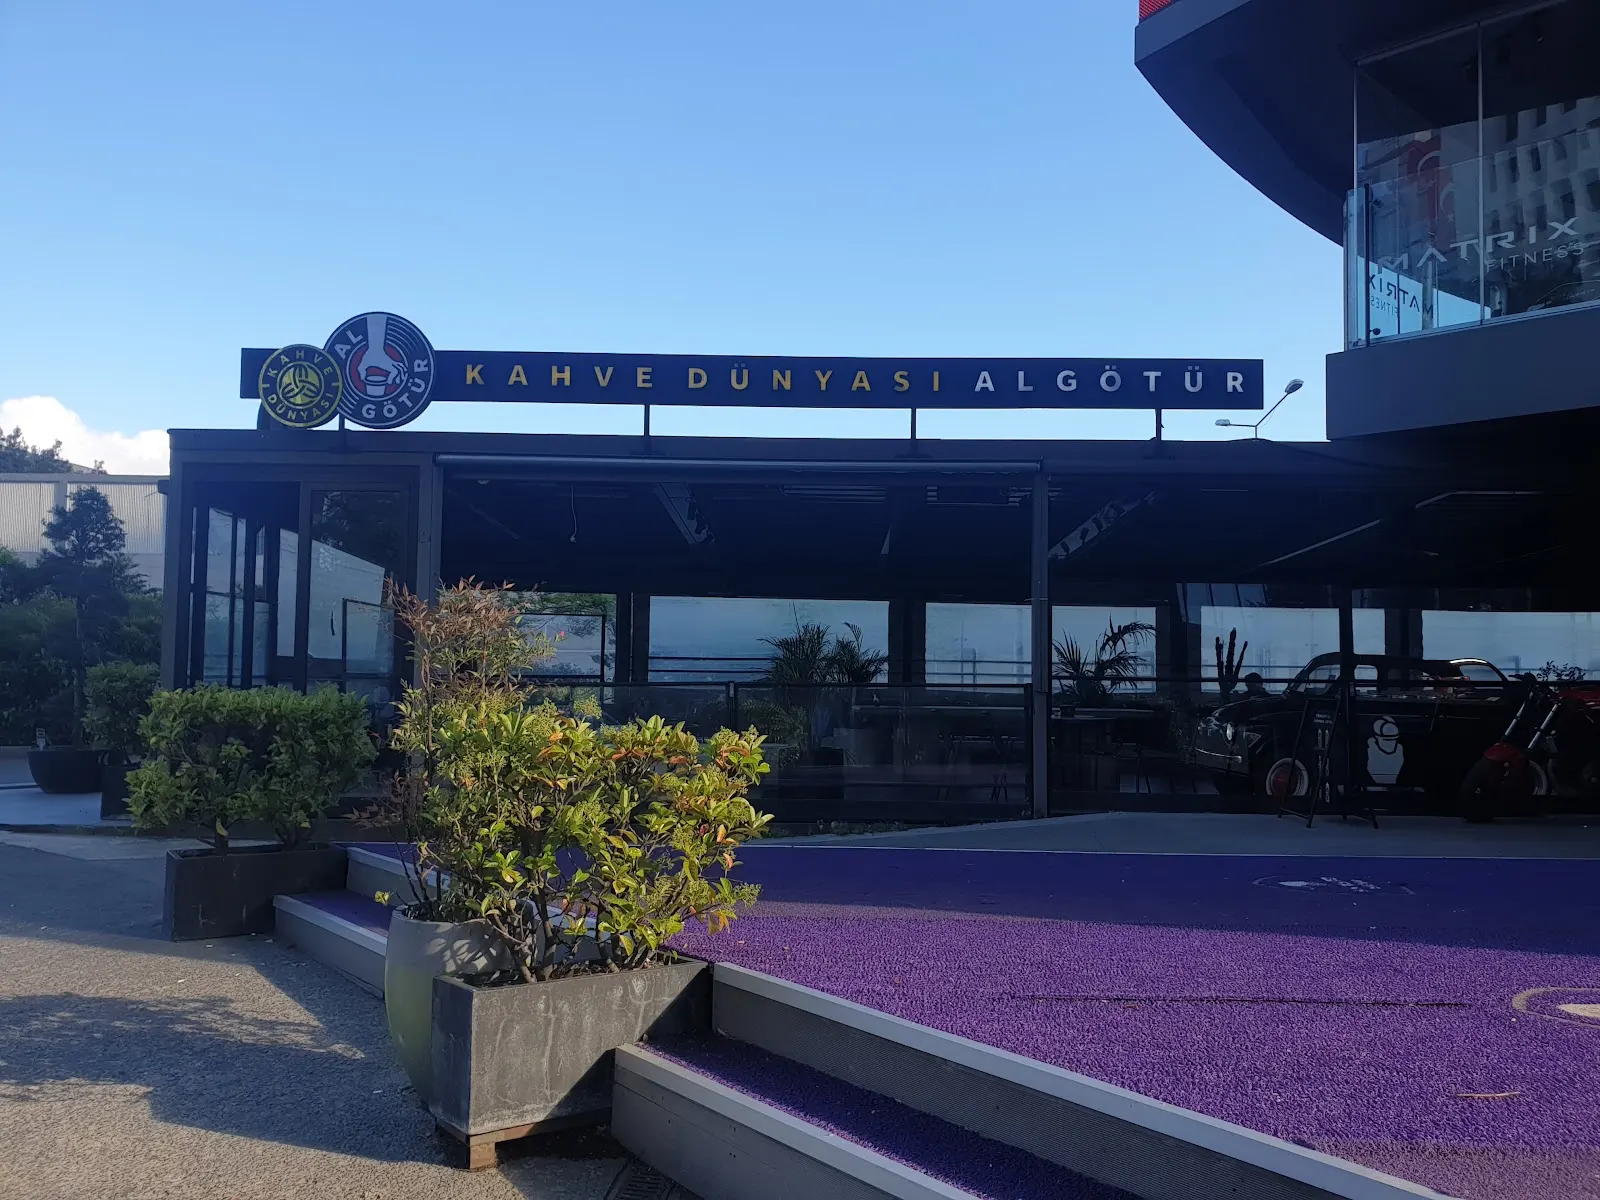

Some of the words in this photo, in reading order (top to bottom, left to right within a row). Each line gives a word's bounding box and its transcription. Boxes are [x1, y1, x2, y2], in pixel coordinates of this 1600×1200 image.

[1377, 216, 1580, 275] MATRIX
[1485, 242, 1584, 273] FITNESS
[267, 350, 333, 378] KAHVE
[334, 329, 364, 360] AL
[361, 358, 429, 419] GÖTÜR
[465, 364, 653, 388] KAHVE
[688, 362, 939, 392] DÜNYASI
[974, 364, 1244, 393] ALGÖTÜR
[268, 392, 334, 421] DÜNYASI
